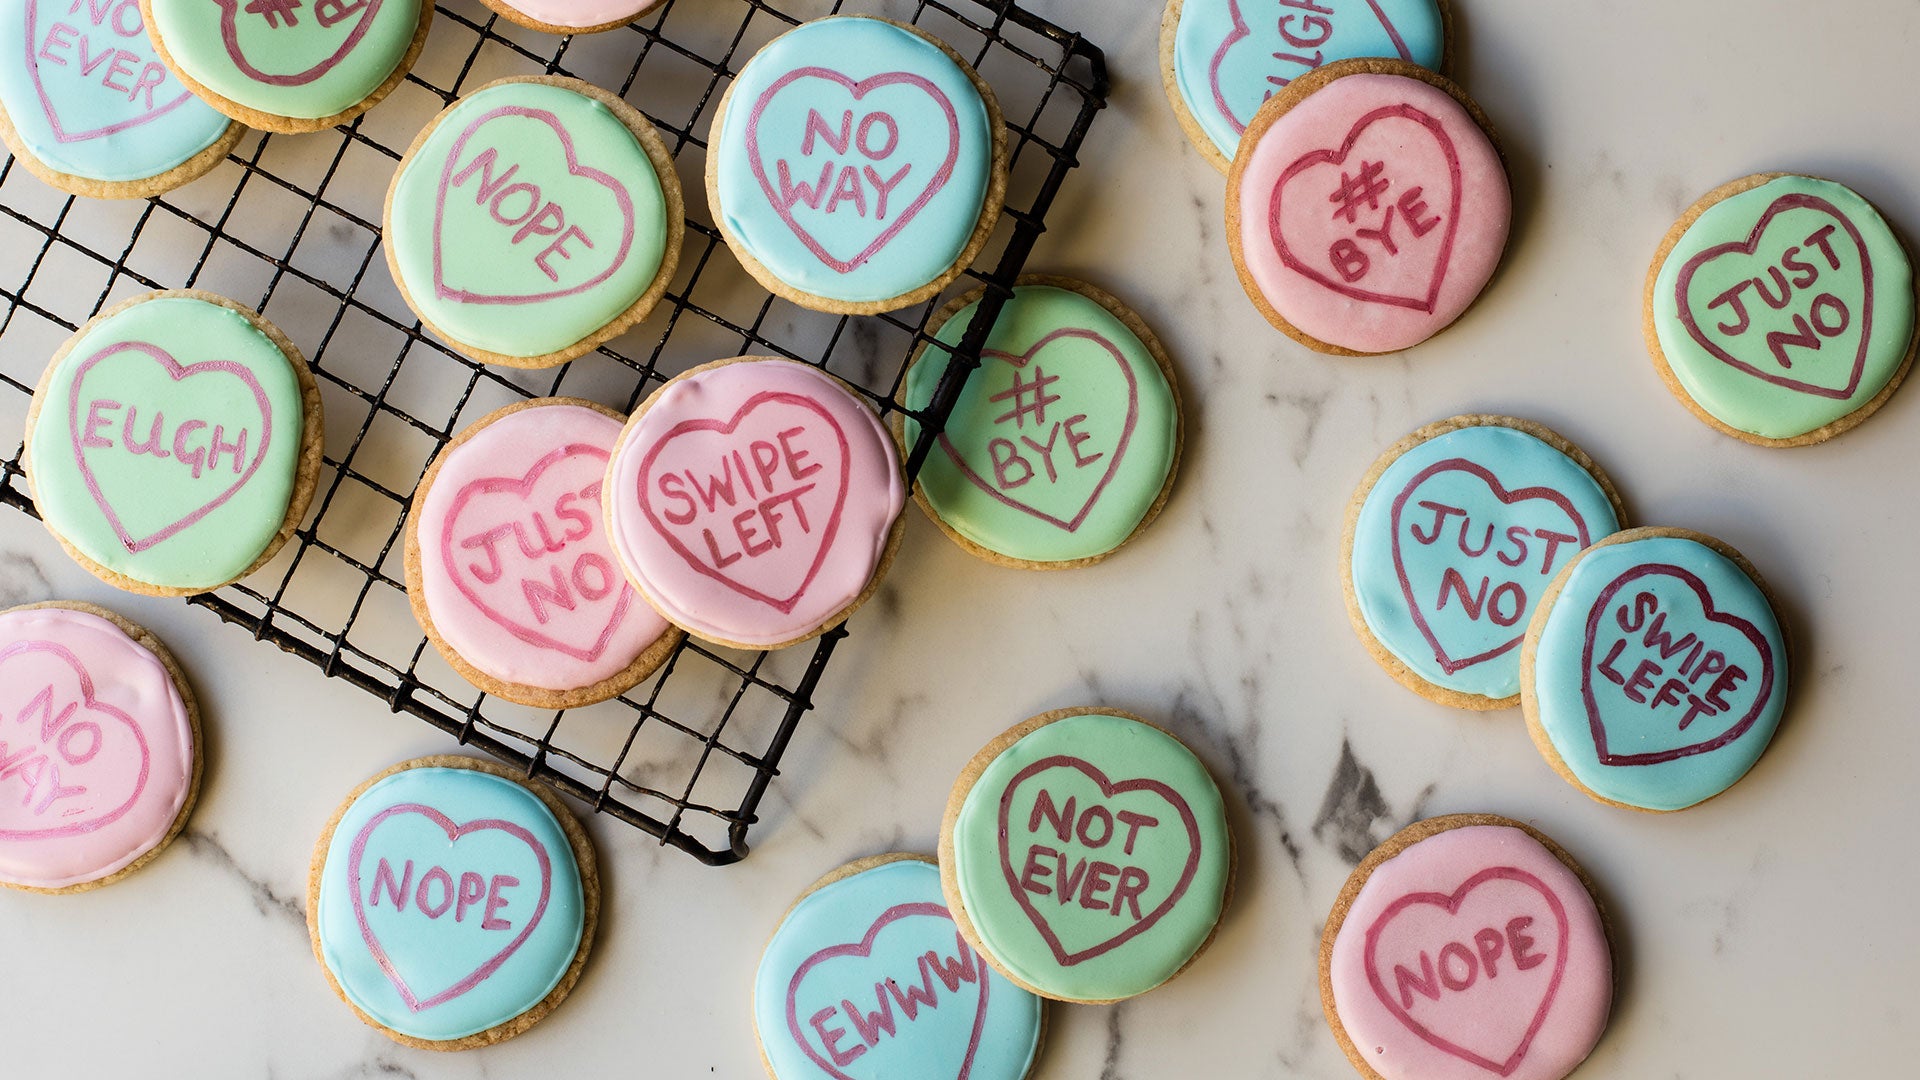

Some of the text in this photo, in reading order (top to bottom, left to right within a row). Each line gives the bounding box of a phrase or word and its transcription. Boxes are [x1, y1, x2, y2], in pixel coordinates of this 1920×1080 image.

[68, 0, 155, 52] NO
[1262, 0, 1334, 103] UG
[38, 22, 166, 110] EVER
[801, 108, 899, 161] NO
[452, 147, 594, 282] NOPE
[777, 159, 912, 220] WAY
[1329, 160, 1389, 224] #
[1329, 186, 1442, 283] BYE
[1707, 224, 1841, 336] JUST
[1767, 293, 1849, 369] NO
[989, 365, 1061, 429] #
[83, 399, 247, 479] EUGH
[658, 426, 823, 526] SWIPE
[988, 414, 1103, 490] BYE
[702, 483, 816, 569] LEFT
[1411, 501, 1578, 574] JUST
[520, 552, 616, 625] NO
[1436, 567, 1528, 627] NO
[1597, 639, 1718, 731] LEFT
[1616, 591, 1748, 712] SWIPE
[17, 683, 102, 766] NO
[1027, 788, 1159, 855] NOT
[368, 857, 520, 930] NOPE
[1020, 844, 1150, 920] EVER
[809, 928, 977, 1067] EWWW
[1394, 916, 1547, 1010] NOPE
